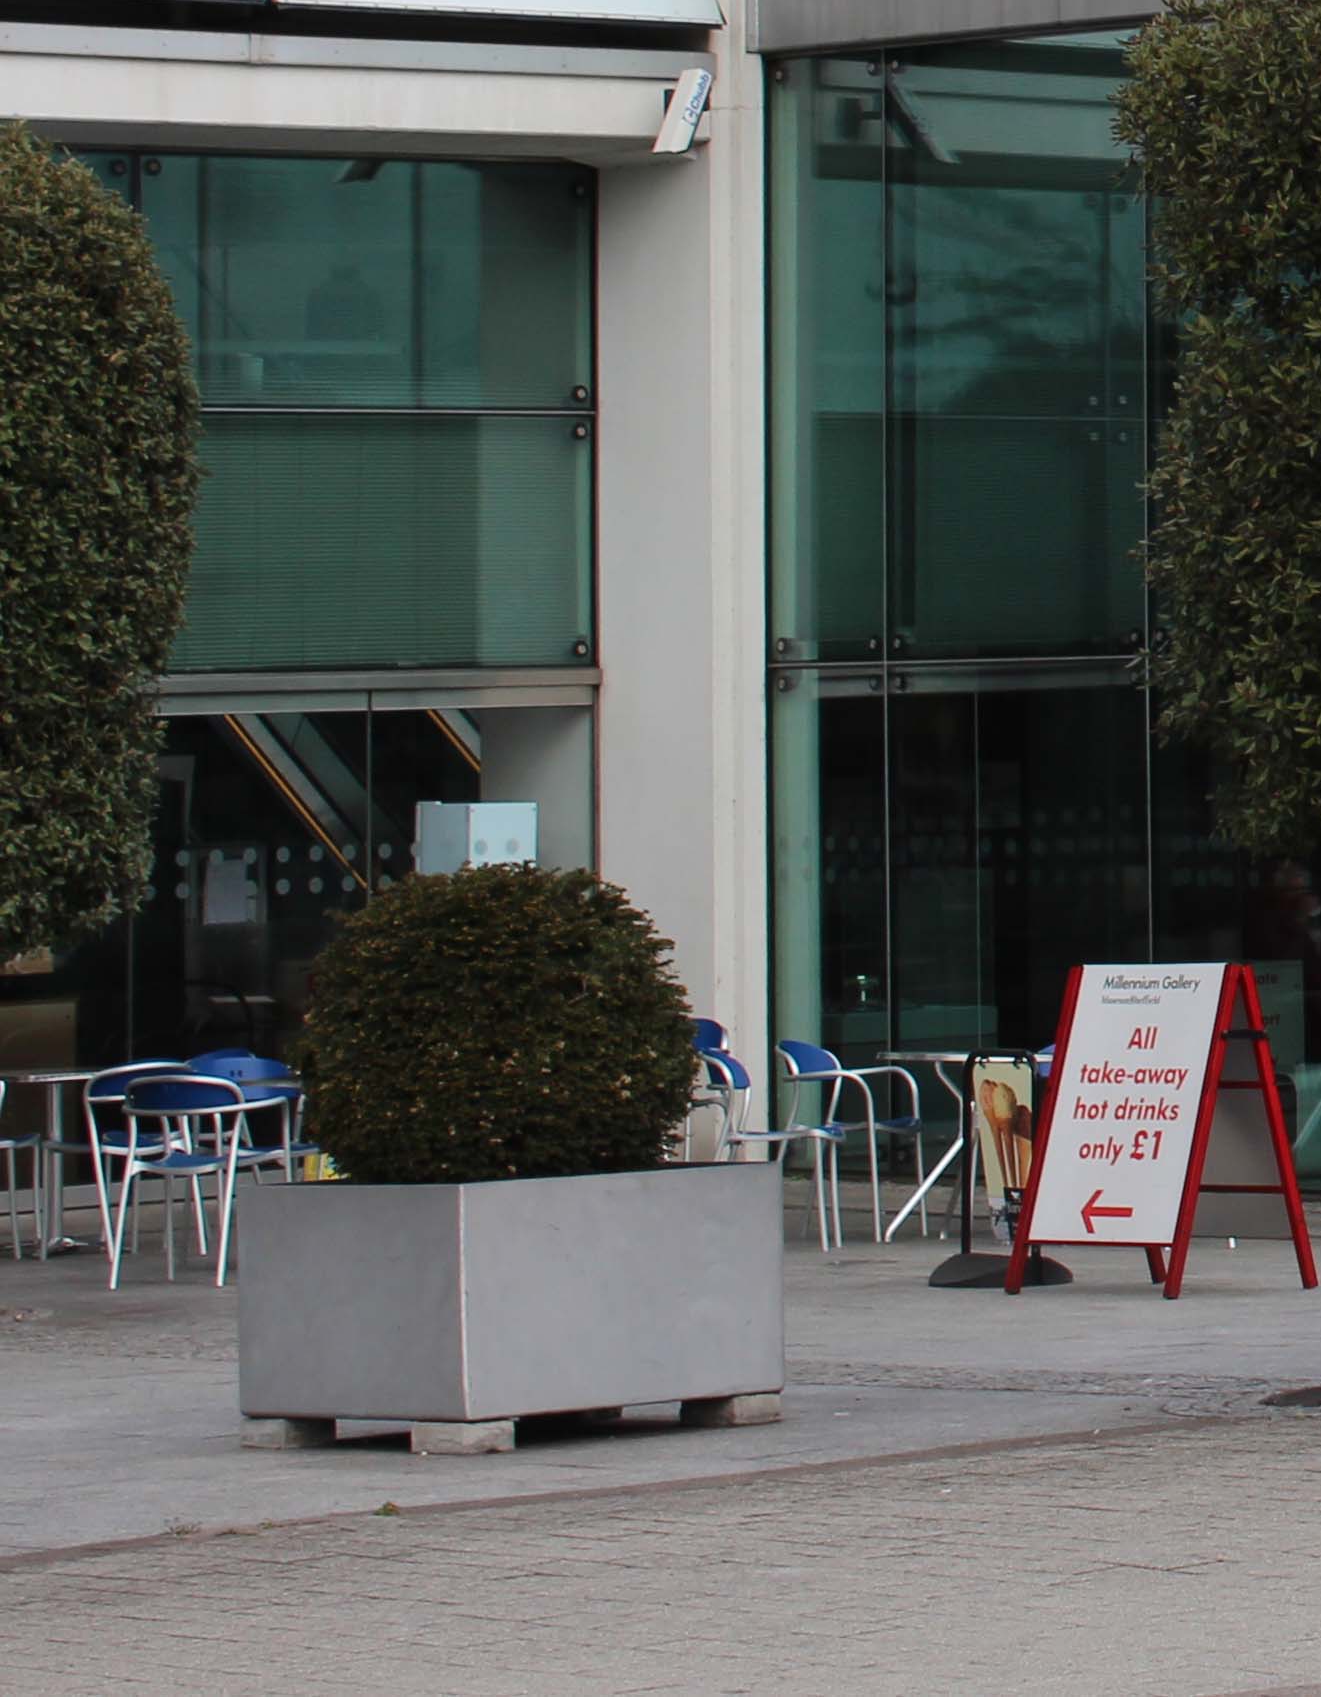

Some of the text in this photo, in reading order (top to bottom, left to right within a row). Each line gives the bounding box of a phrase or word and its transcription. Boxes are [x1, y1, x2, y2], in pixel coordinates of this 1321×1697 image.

[1103, 975, 1201, 993] Millennium Gallery
[1127, 1026, 1158, 1050] All
[1080, 1060, 1189, 1091] take-away
[1073, 1095, 1180, 1121] hot drinks
[1079, 1129, 1164, 1166] only £1
